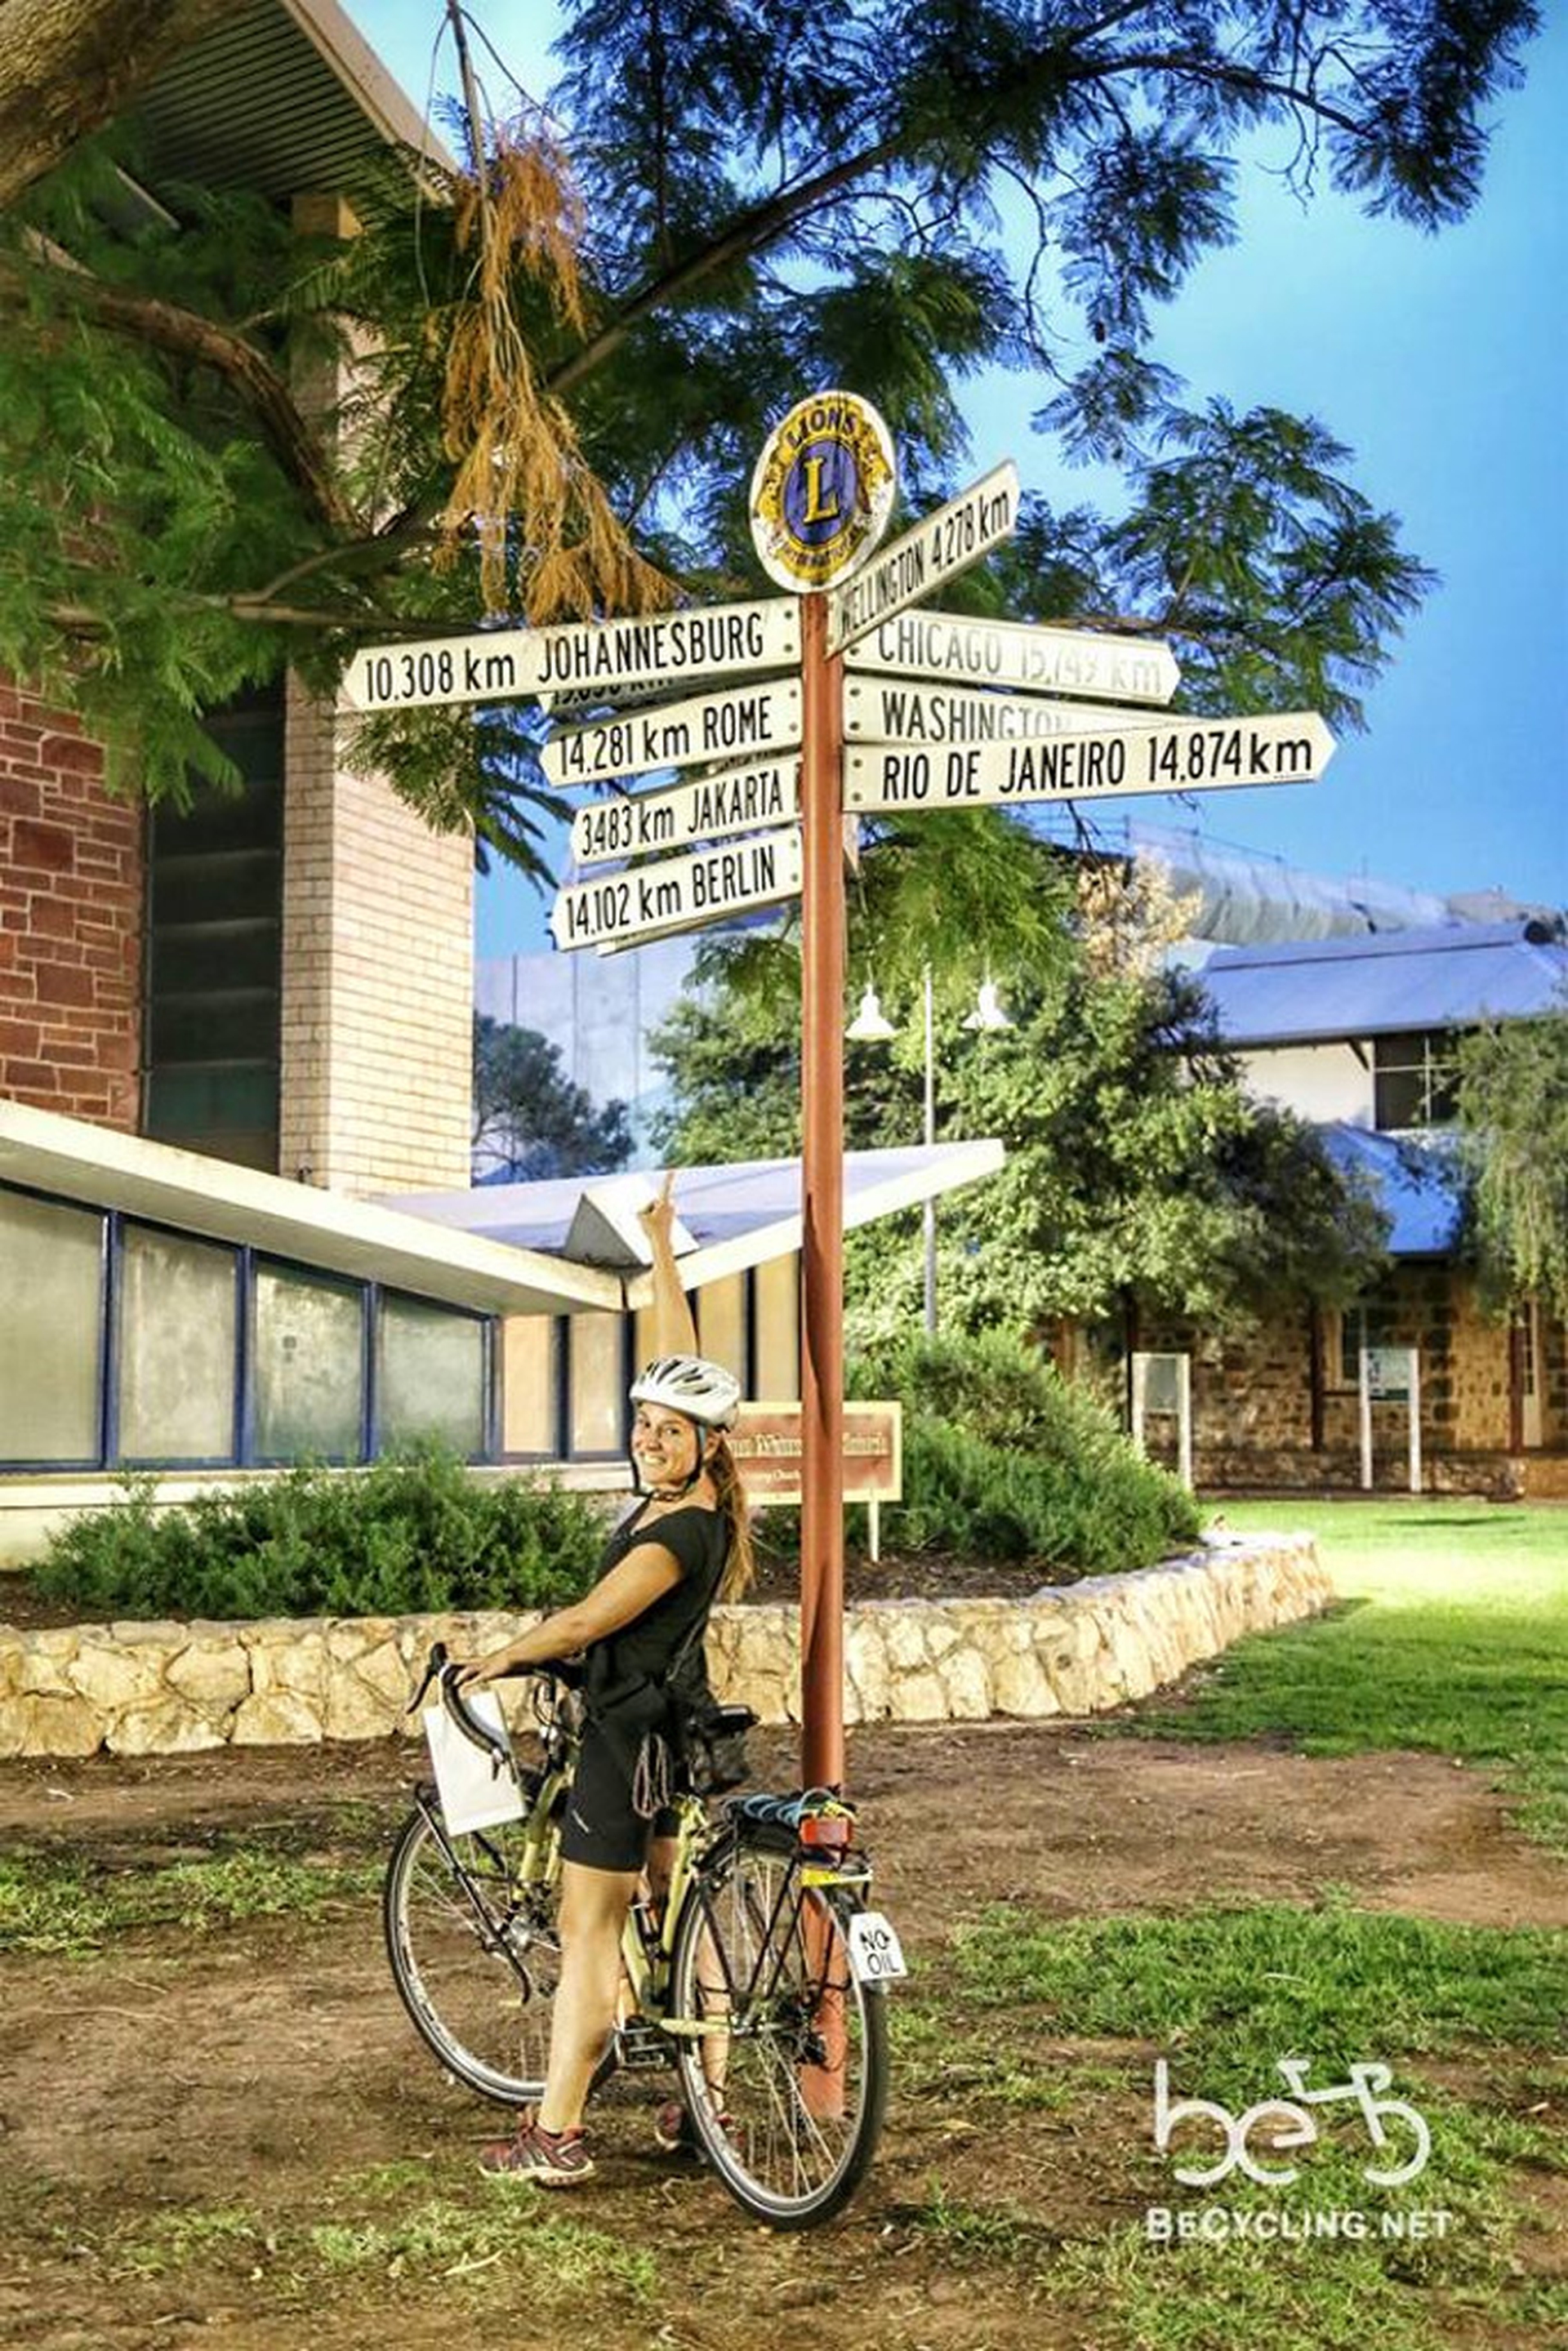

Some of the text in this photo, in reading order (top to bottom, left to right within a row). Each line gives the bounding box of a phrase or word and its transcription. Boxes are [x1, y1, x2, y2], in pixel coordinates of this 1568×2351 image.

[786, 406, 857, 447] LIONS
[979, 491, 1009, 542] km
[367, 650, 454, 703] 10.308
[465, 647, 515, 692] km
[537, 612, 764, 683] JOHANNESBURG
[878, 618, 1002, 675] CHICAGO
[559, 695, 773, 777] 14.281 km ROME
[883, 729, 1312, 800] RIO DE JANEIRO 14.874 km
[639, 799, 675, 844] km
[688, 768, 783, 834] JAKARTA
[567, 844, 776, 938] 14.102 km BERLIN
[860, 1928, 890, 1952] NO
[867, 1952, 900, 1975] OIL
